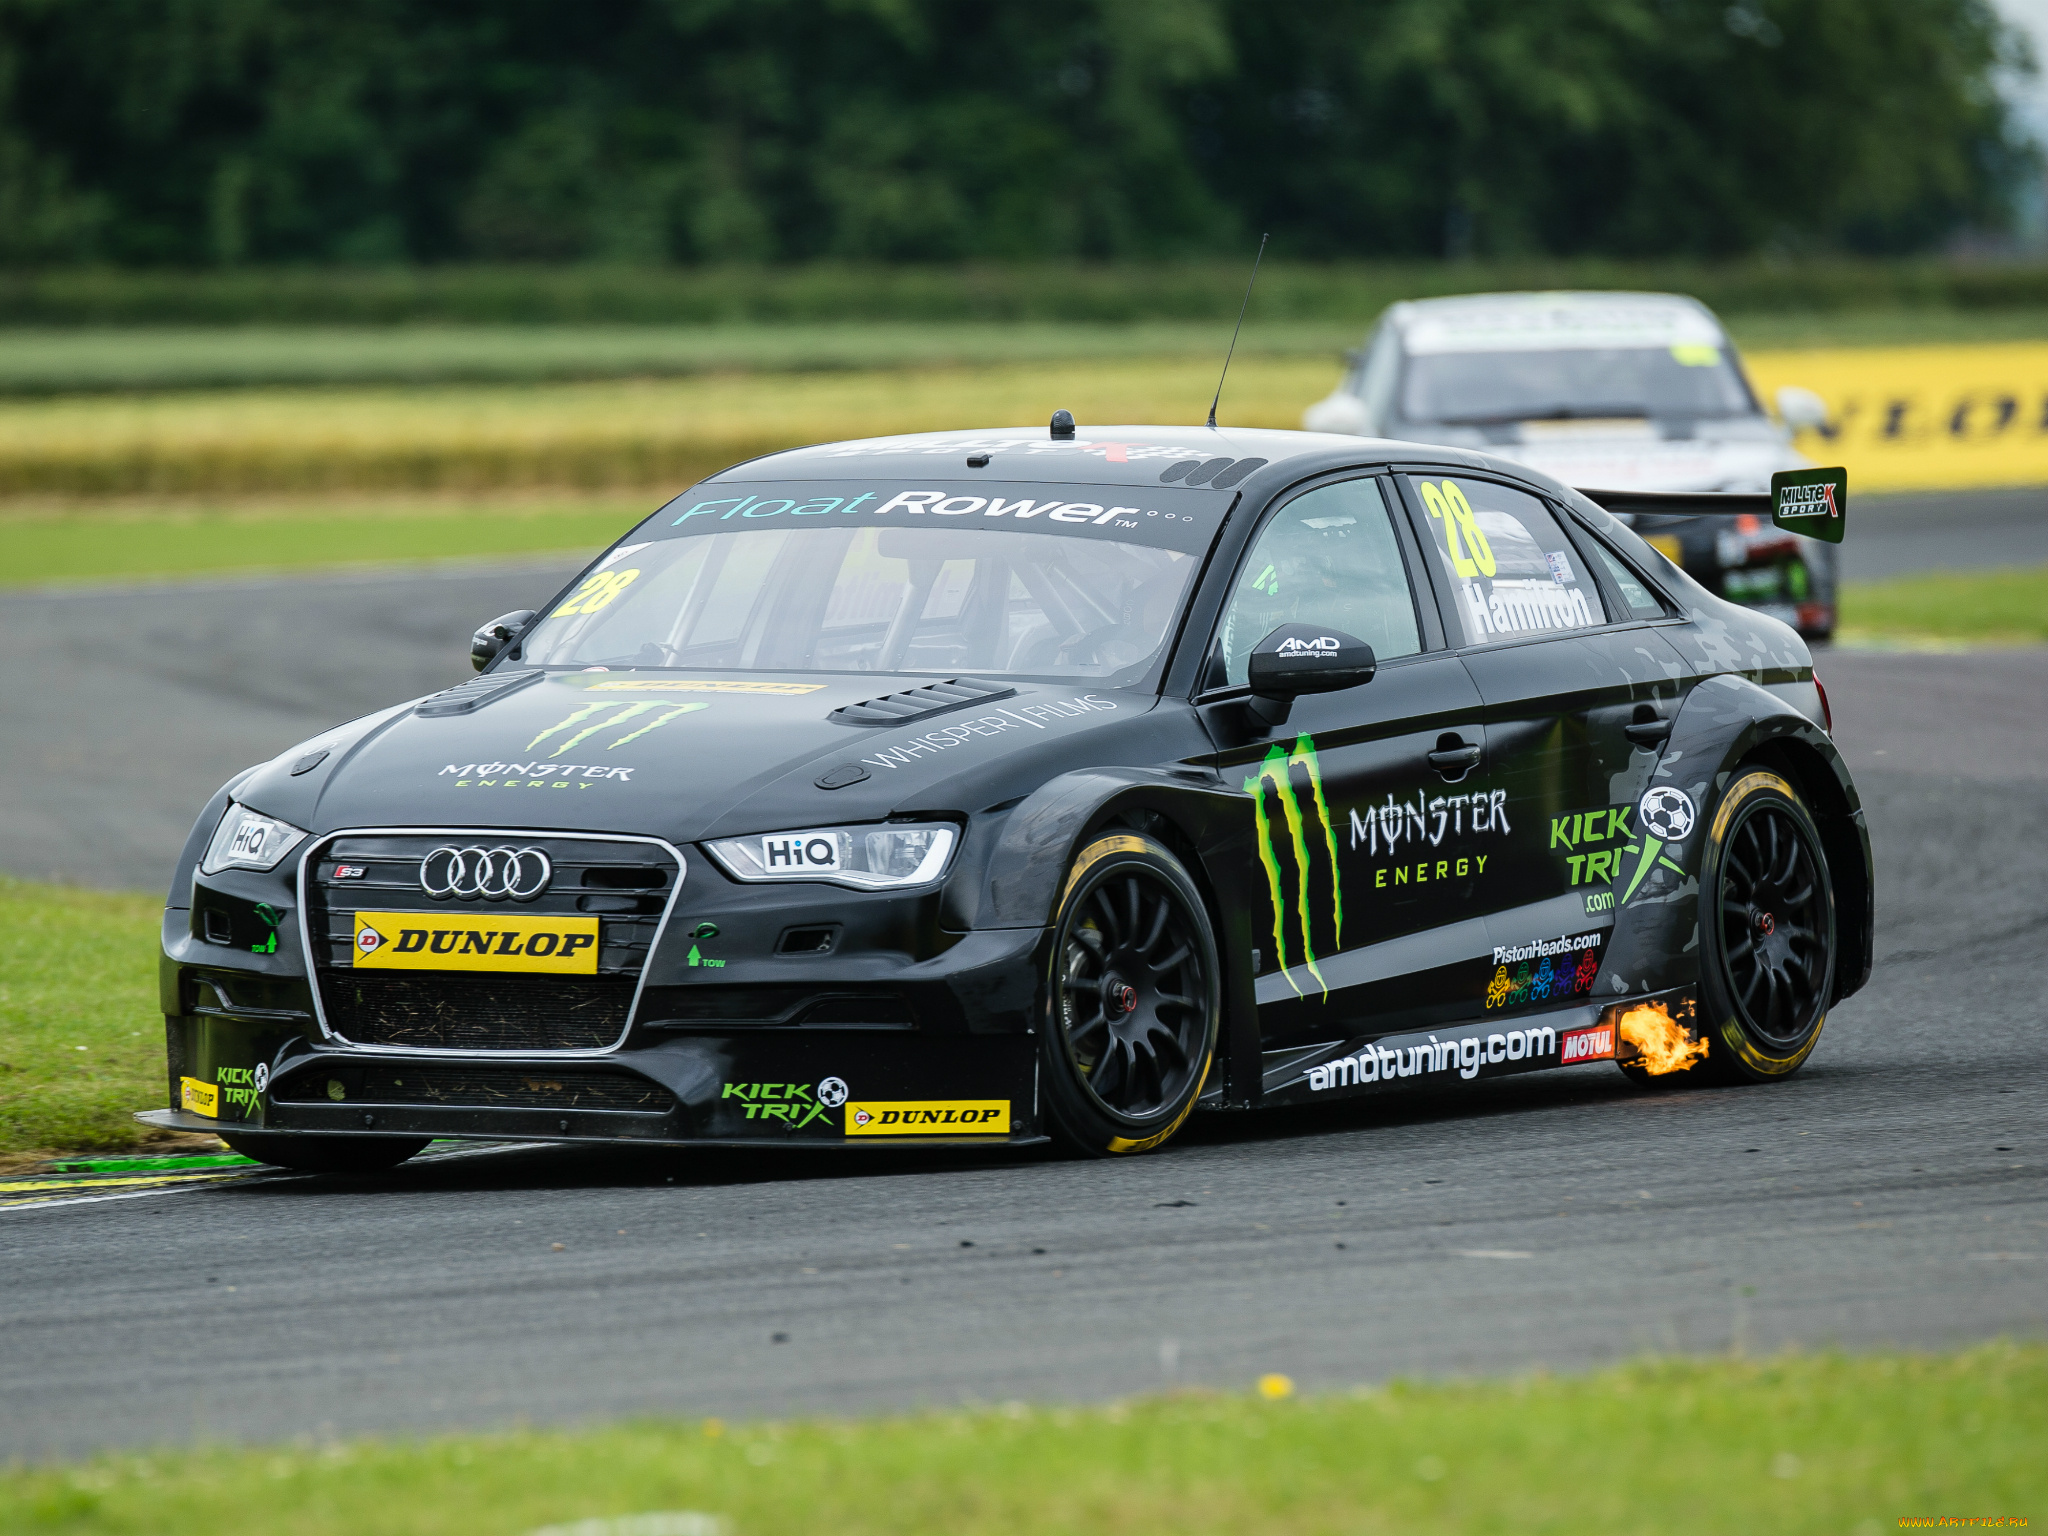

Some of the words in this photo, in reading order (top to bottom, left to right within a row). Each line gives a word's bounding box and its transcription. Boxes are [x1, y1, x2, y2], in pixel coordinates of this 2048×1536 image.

[1783, 504, 1823, 515] SPORT
[1420, 479, 1497, 579] 28
[550, 568, 640, 618] 28
[1461, 578, 1593, 635] Hamilton
[1275, 636, 1341, 652] AMD
[1279, 650, 1338, 658] amdtuning.com
[455, 780, 594, 789] ENERGY
[231, 825, 265, 854] HiQ
[1550, 806, 1638, 852] KICK
[767, 838, 836, 867] HiQ
[341, 868, 364, 877] S3
[1375, 855, 1487, 888] ENERGY
[1566, 833, 1686, 905] TRIX
[1586, 891, 1615, 913] .com
[391, 929, 595, 957] DUNLOP
[1493, 933, 1601, 965] PistonHeads.com
[702, 958, 726, 968] TOW
[1304, 1026, 1556, 1090] amdtuning.com
[1563, 1029, 1613, 1060] MOTUL
[216, 1067, 254, 1088] KICK
[224, 1086, 262, 1118] TRIX
[721, 1083, 813, 1102] KICK
[741, 1101, 834, 1129] TRIX
[878, 1109, 1001, 1124] DUNLOP
